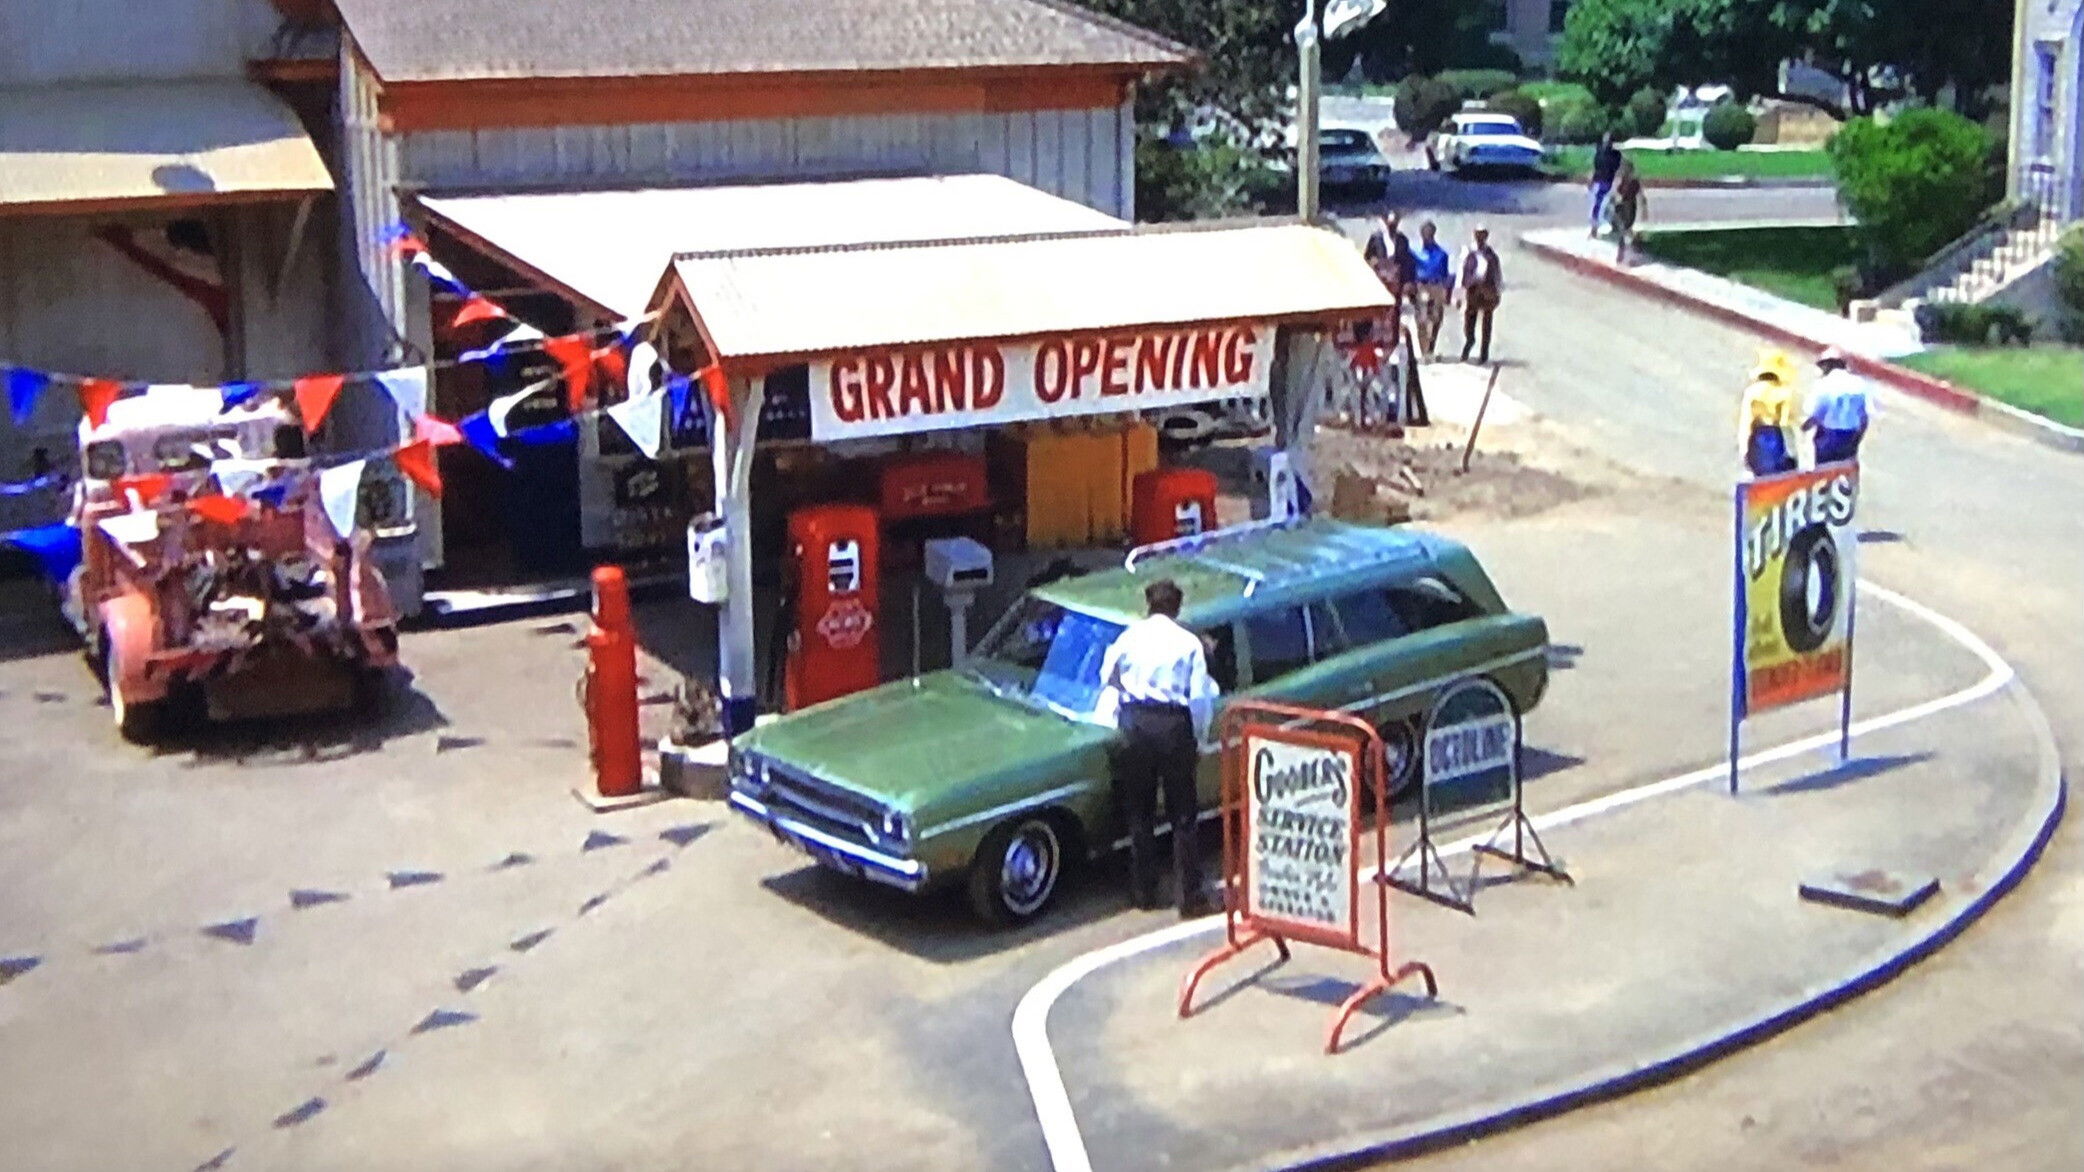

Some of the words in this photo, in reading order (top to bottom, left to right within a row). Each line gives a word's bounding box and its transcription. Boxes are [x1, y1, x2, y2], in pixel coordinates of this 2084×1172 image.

[829, 346, 1006, 423] GRAND
[1034, 324, 1257, 403] OPENING
[1747, 474, 1856, 580] TIRES
[1256, 834, 1347, 867] STATION
[1257, 808, 1346, 840] SERVICE
